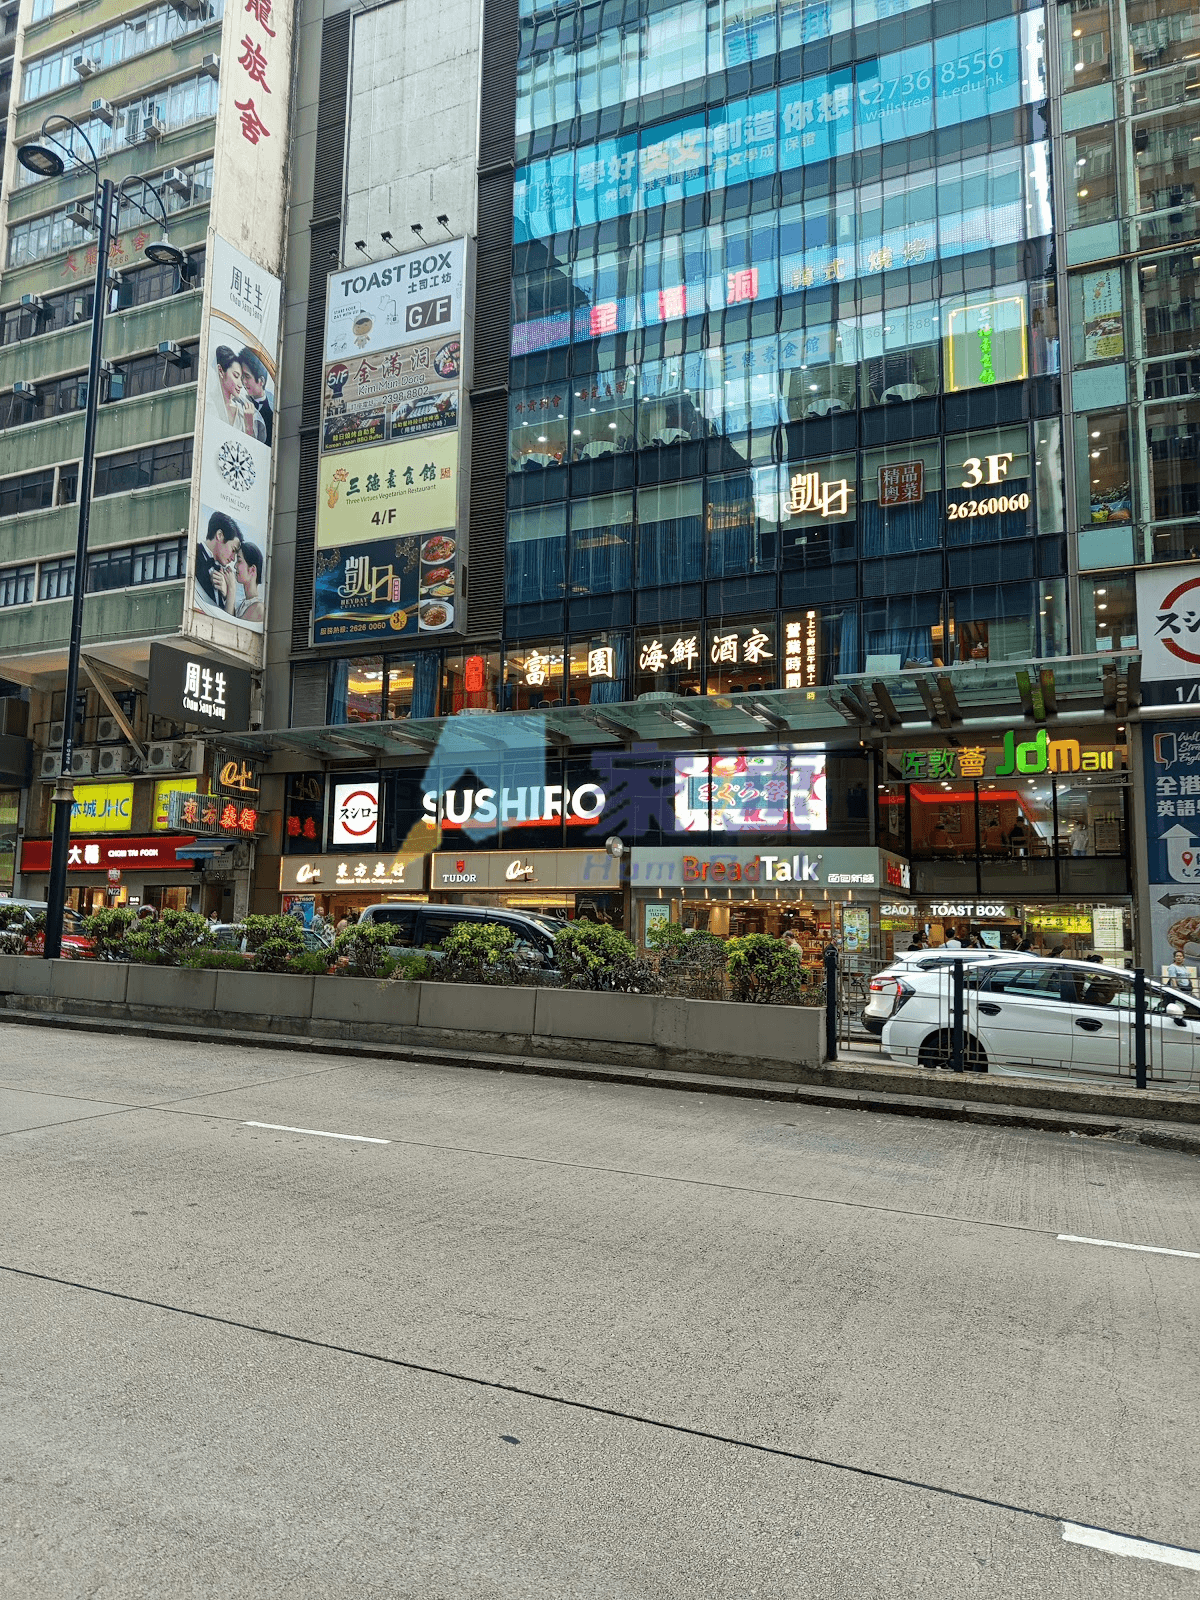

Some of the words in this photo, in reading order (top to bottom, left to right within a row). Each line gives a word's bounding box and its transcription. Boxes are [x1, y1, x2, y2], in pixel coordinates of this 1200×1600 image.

[872, 73, 930, 107] 2736
[940, 47, 1004, 84] 8556
[341, 264, 405, 297] TOAST
[409, 251, 452, 279] BOX
[407, 272, 452, 294] 土司工坊
[231, 266, 262, 311] 周生生
[408, 299, 449, 328] G/F
[327, 369, 348, 387] 5/F
[352, 346, 431, 386] 金滿洞
[358, 384, 376, 396] Kim
[378, 379, 398, 393] Mun
[401, 373, 426, 388] Dong
[382, 393, 405, 405] 2398
[406, 386, 429, 400] 8802
[346, 462, 437, 497] 三德素食館
[962, 453, 1013, 488] 3F
[346, 496, 361, 505] Three
[361, 494, 378, 503] Virtues
[379, 488, 407, 500] Vegetarian
[408, 484, 437, 496] Restaurant
[784, 472, 855, 517] 凱日
[948, 493, 1029, 521] 26260060
[371, 508, 397, 526] 4/F
[184, 662, 226, 704] 周生生
[1176, 684, 1200, 702] 1/
[183, 697, 198, 711] Chow
[199, 701, 211, 717] Sang
[212, 705, 226, 720] Sang
[901, 746, 987, 779] 佐敦薈
[98, 798, 130, 818] JHC
[339, 807, 378, 820] スシロー
[421, 783, 606, 824] SUSHIRO
[443, 874, 477, 883] TUDOR
[682, 855, 819, 882] BreadTalk
[930, 905, 975, 916] TOAST
[976, 905, 1006, 917] BOX
